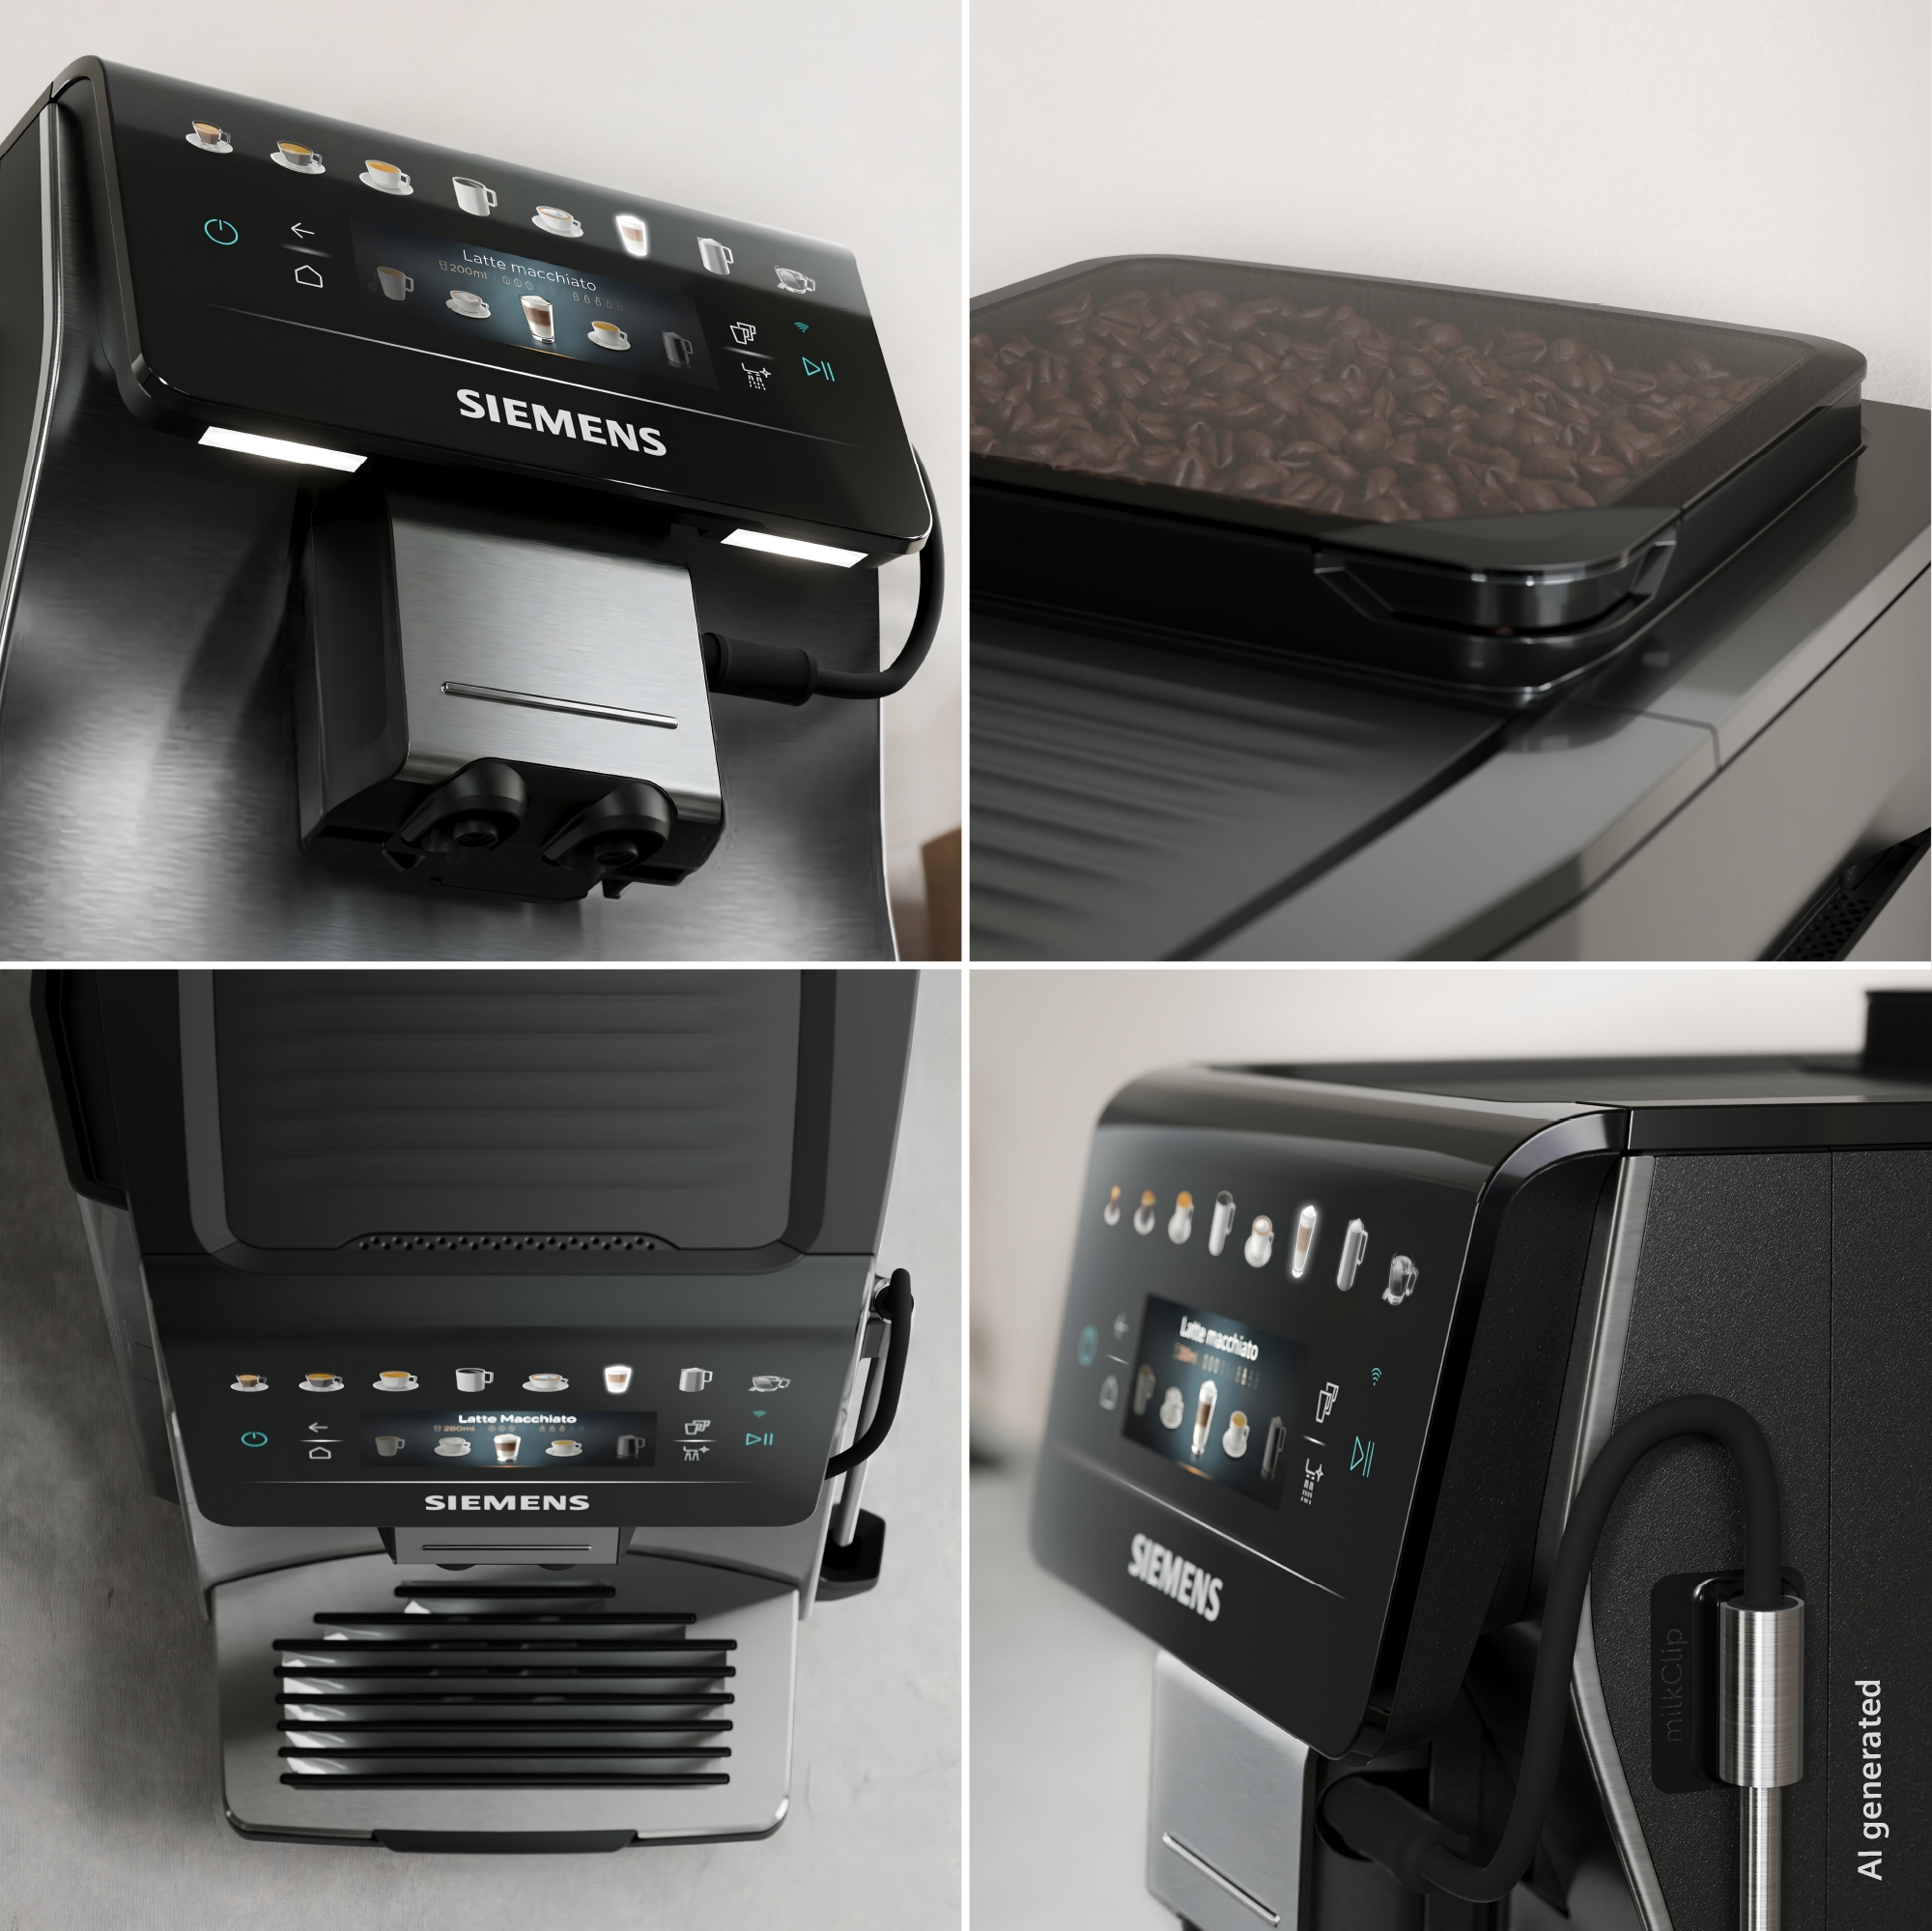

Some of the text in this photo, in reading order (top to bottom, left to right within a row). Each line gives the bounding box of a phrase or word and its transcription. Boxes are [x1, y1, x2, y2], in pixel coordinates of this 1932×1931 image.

[449, 263, 489, 280] 200ml
[462, 249, 597, 292] Latte macchiato
[456, 388, 668, 457] SIEMENS
[1179, 1316, 1208, 1343] Latte
[1206, 1329, 1259, 1361] macchiato
[458, 1414, 578, 1424] Latte Macchiato
[424, 1495, 590, 1511] SIEMENS
[1127, 1532, 1224, 1622] SIEMENS
[1661, 1628, 1688, 1742] milkClip
